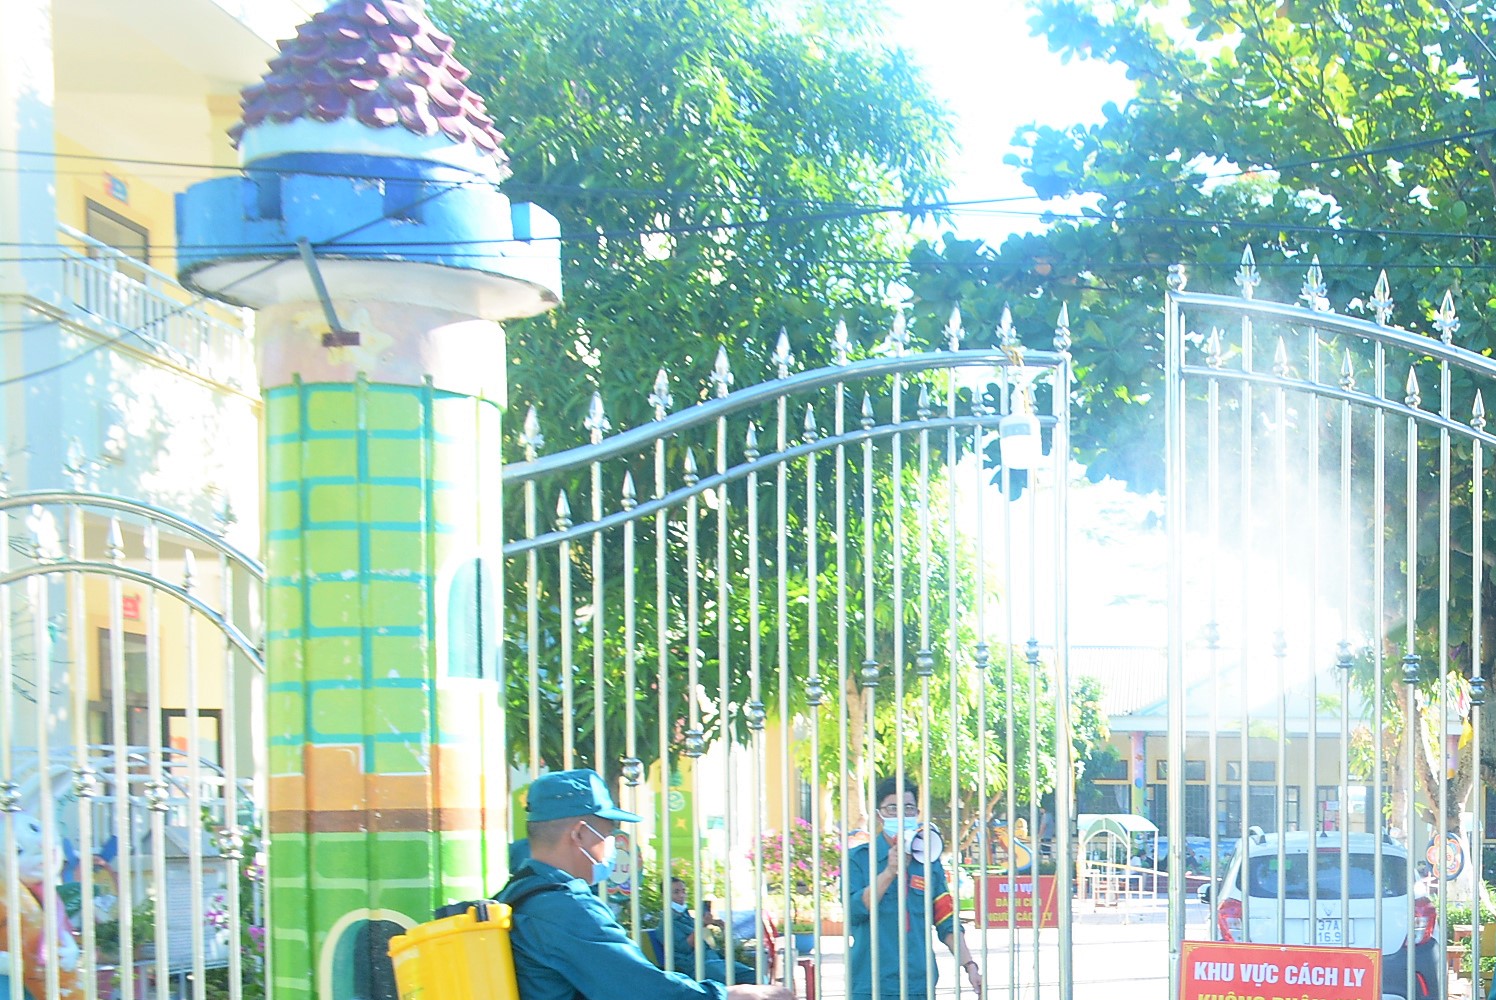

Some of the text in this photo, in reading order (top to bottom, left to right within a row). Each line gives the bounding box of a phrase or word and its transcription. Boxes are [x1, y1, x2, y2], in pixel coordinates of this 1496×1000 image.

[1318, 920, 1339, 931] 37A
[1318, 931, 1341, 942] 16.9
[1194, 961, 1366, 987] KHU VỰC CÁCH LY
